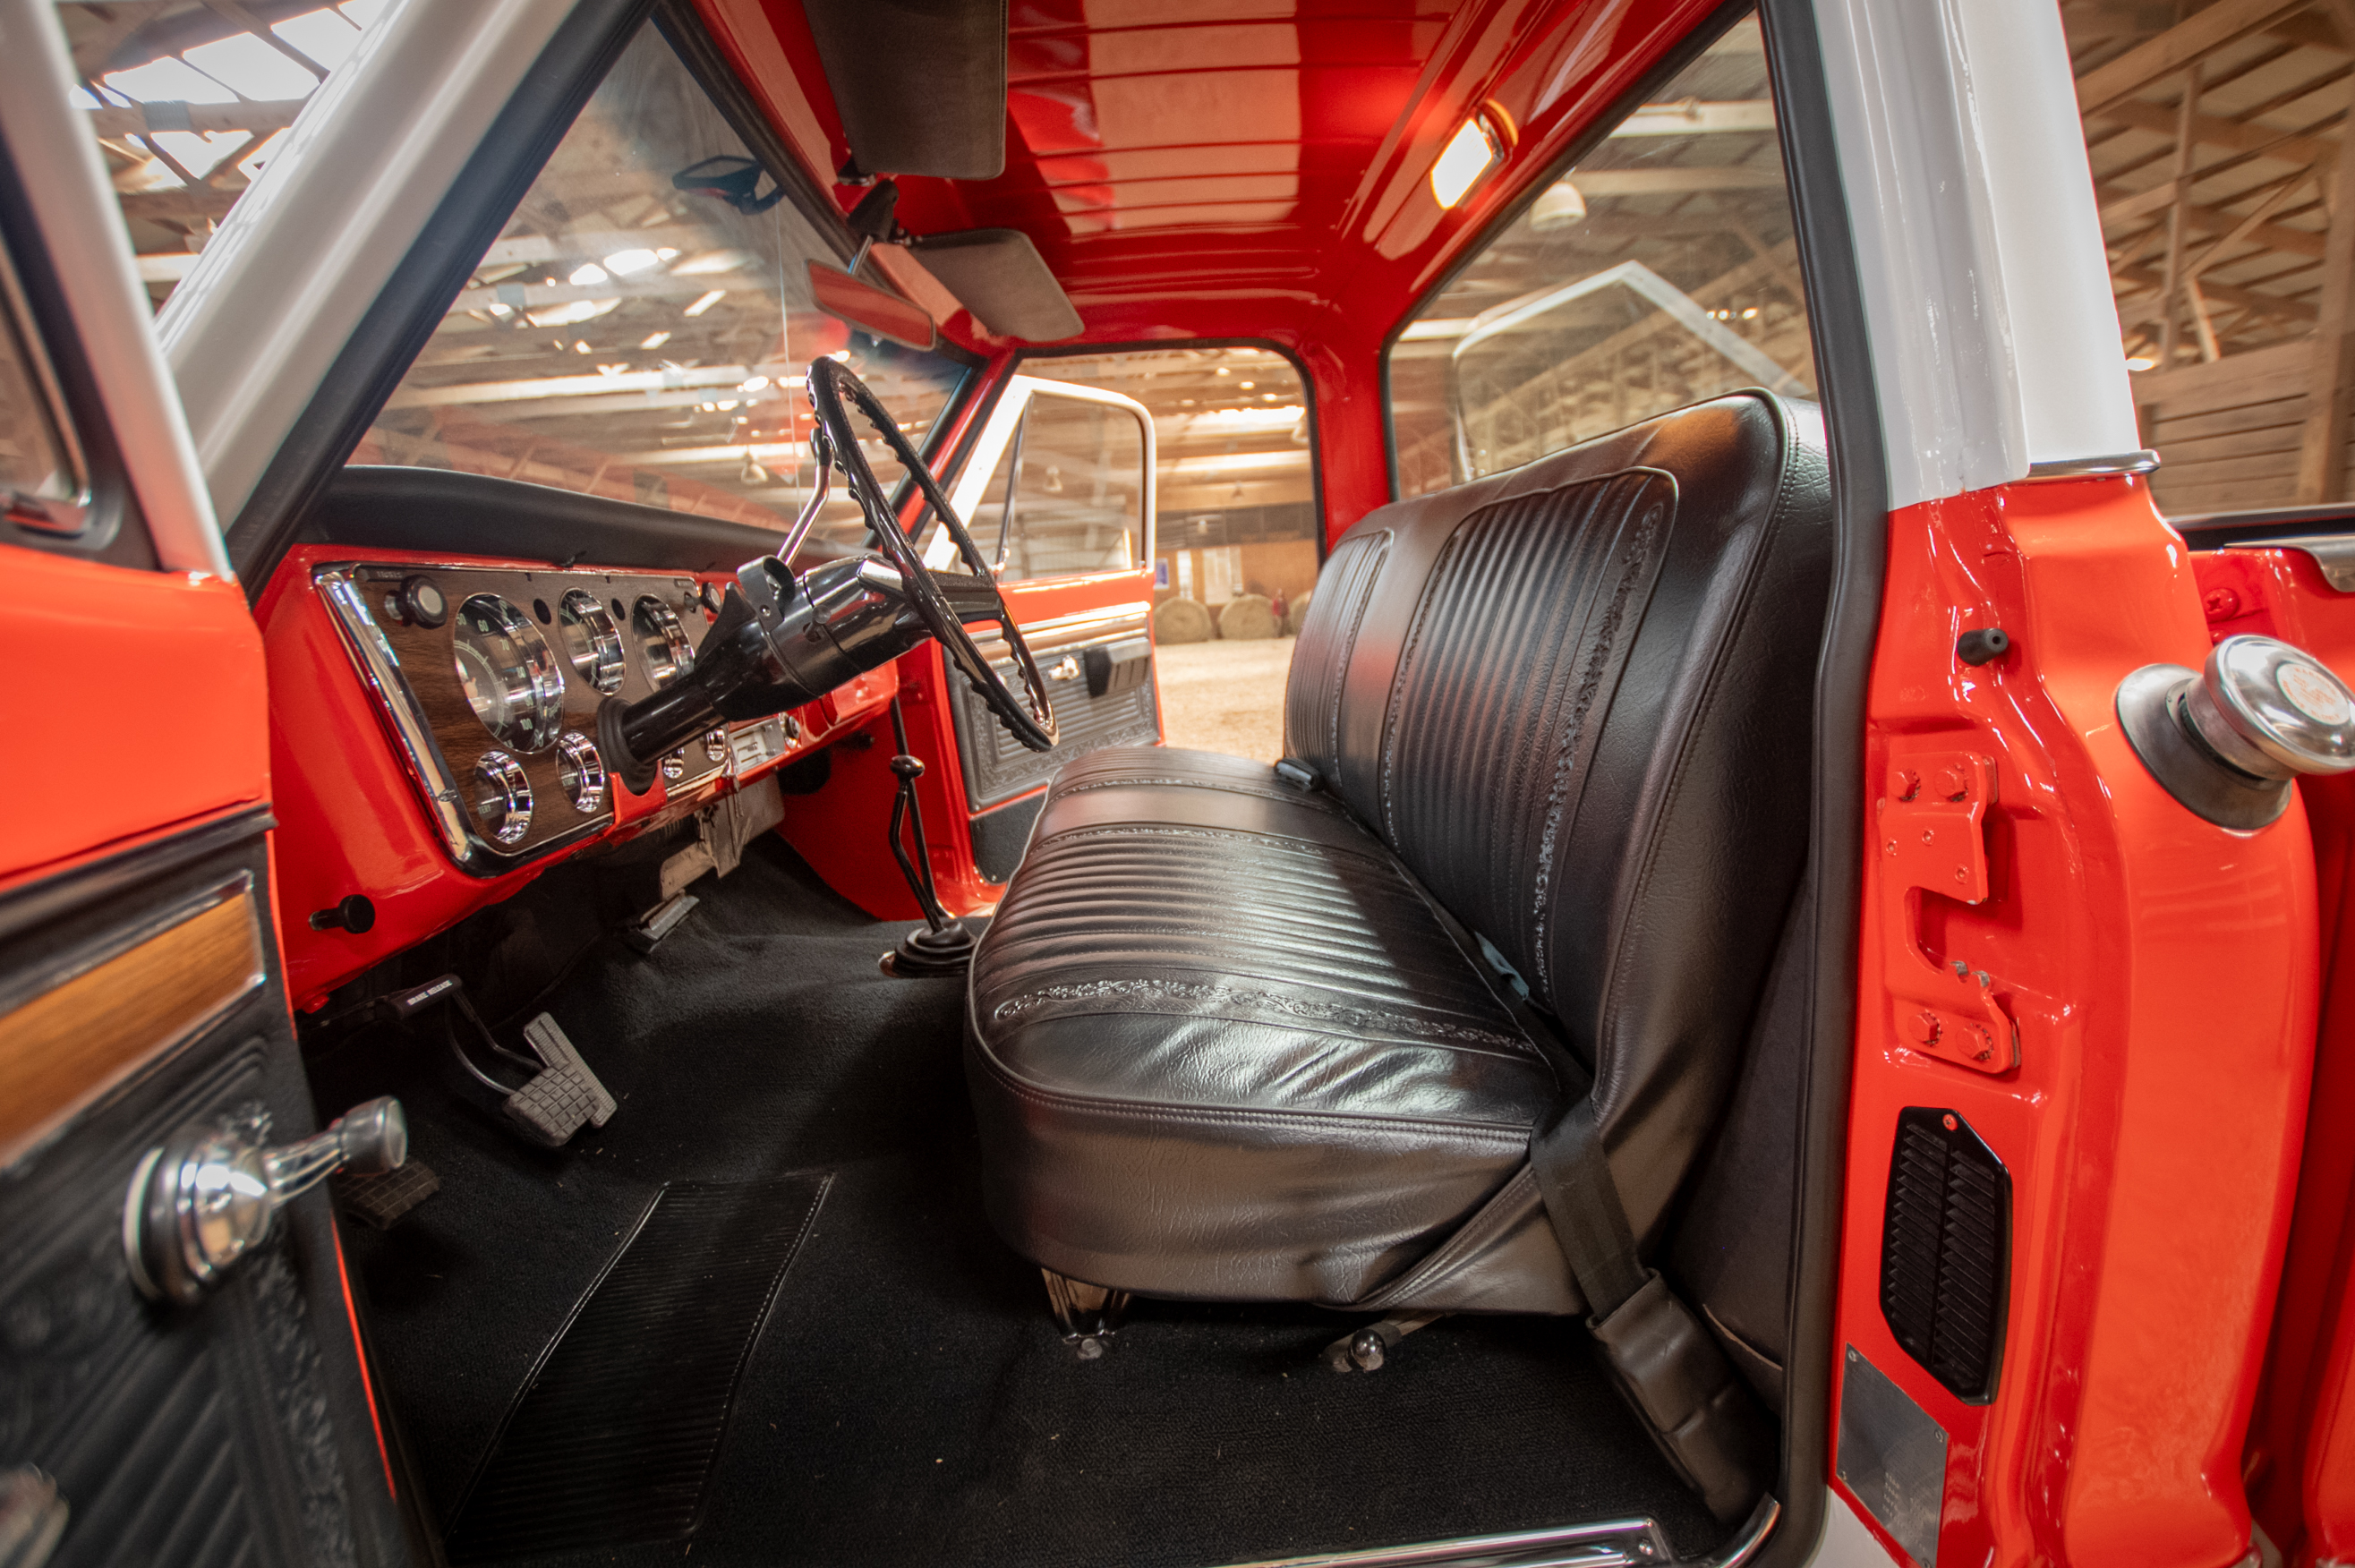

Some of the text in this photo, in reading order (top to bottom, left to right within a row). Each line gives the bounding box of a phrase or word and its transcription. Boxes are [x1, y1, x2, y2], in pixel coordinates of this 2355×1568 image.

[477, 619, 489, 632] 60
[499, 639, 510, 652] 70
[516, 666, 526, 678] 80
[520, 718, 533, 730] 100
[406, 979, 453, 1006] BRAKE RELEASE
